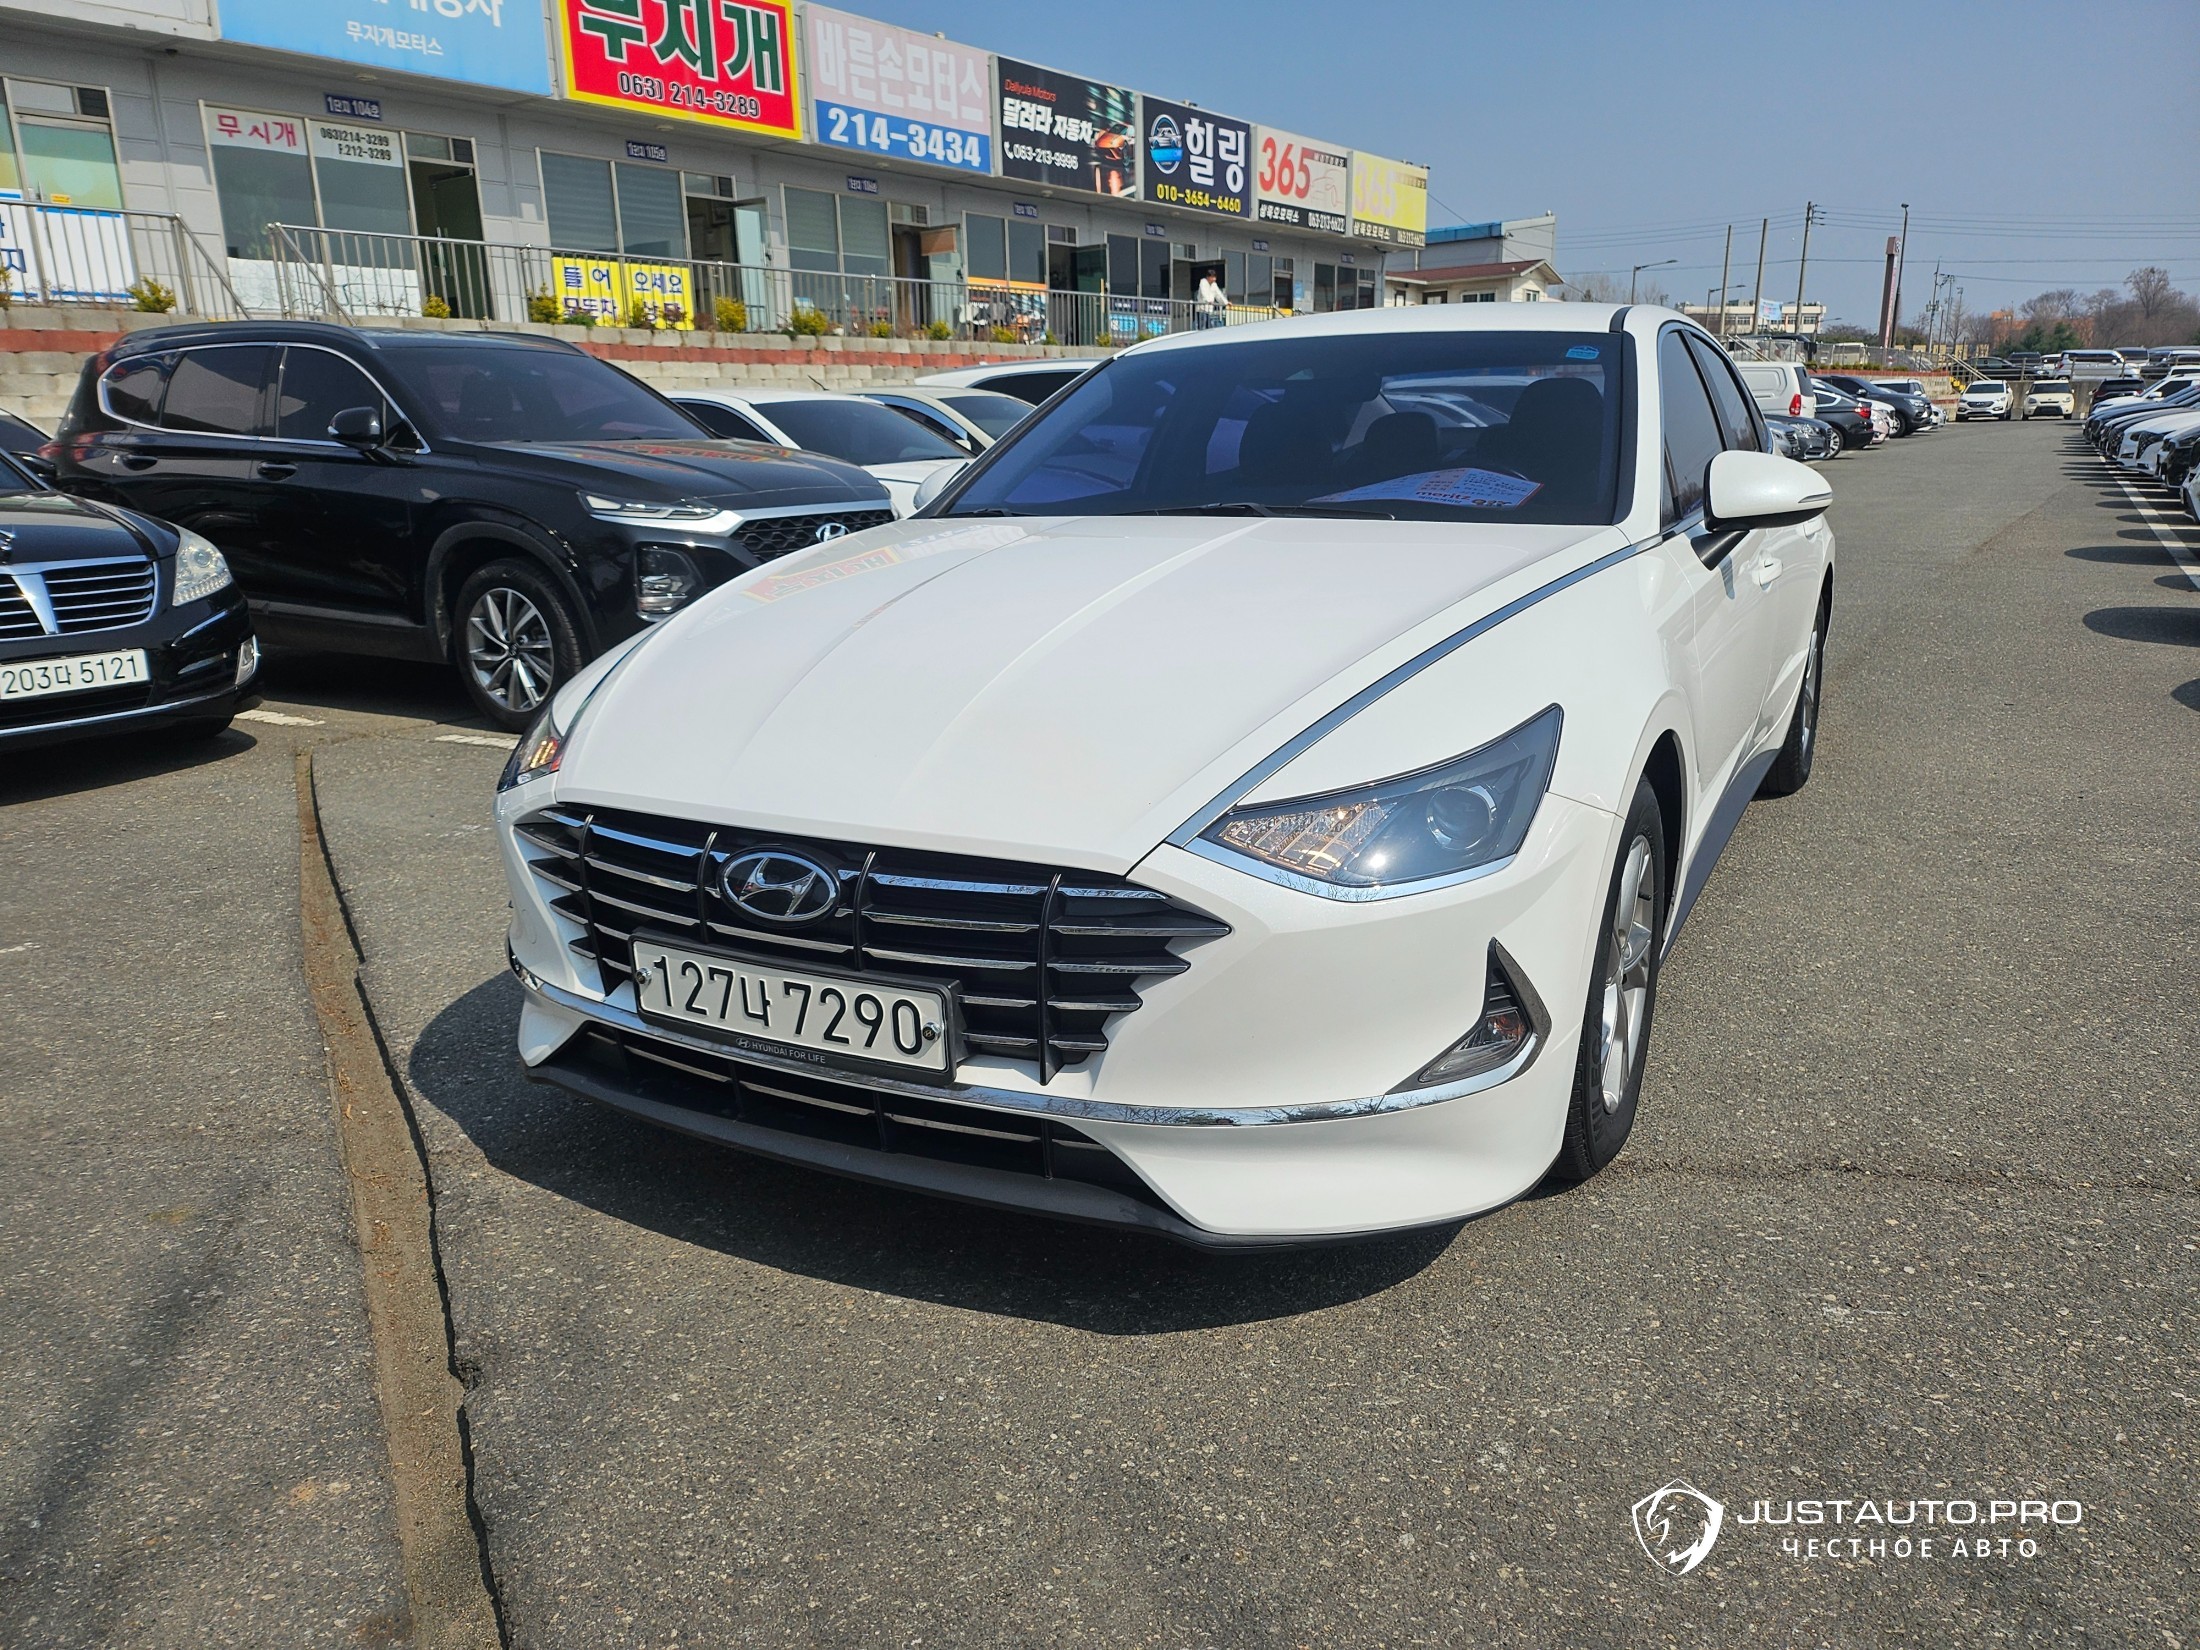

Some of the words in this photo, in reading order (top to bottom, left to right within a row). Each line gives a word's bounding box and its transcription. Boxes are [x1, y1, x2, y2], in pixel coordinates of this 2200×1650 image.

[345, 20, 444, 56] 무지개모터스
[815, 19, 984, 122] 바른손모터스
[618, 72, 664, 100] 063)
[670, 82, 760, 118] 214-3289
[828, 107, 981, 167] 214-3434
[1003, 97, 1053, 135] 달려라
[1053, 114, 1094, 144] 자동차
[1184, 117, 1247, 194] 힐링
[1259, 137, 1310, 199] 365
[1157, 183, 1242, 213] 010-3654-6460
[1, 664, 72, 695] 203다
[80, 654, 139, 684] 5121
[652, 954, 773, 1027] 127나
[782, 979, 923, 1056] 7290
[752, 1041, 788, 1056] HYUNDAI
[789, 1049, 807, 1060] FOR
[808, 1053, 826, 1064] LIFE
